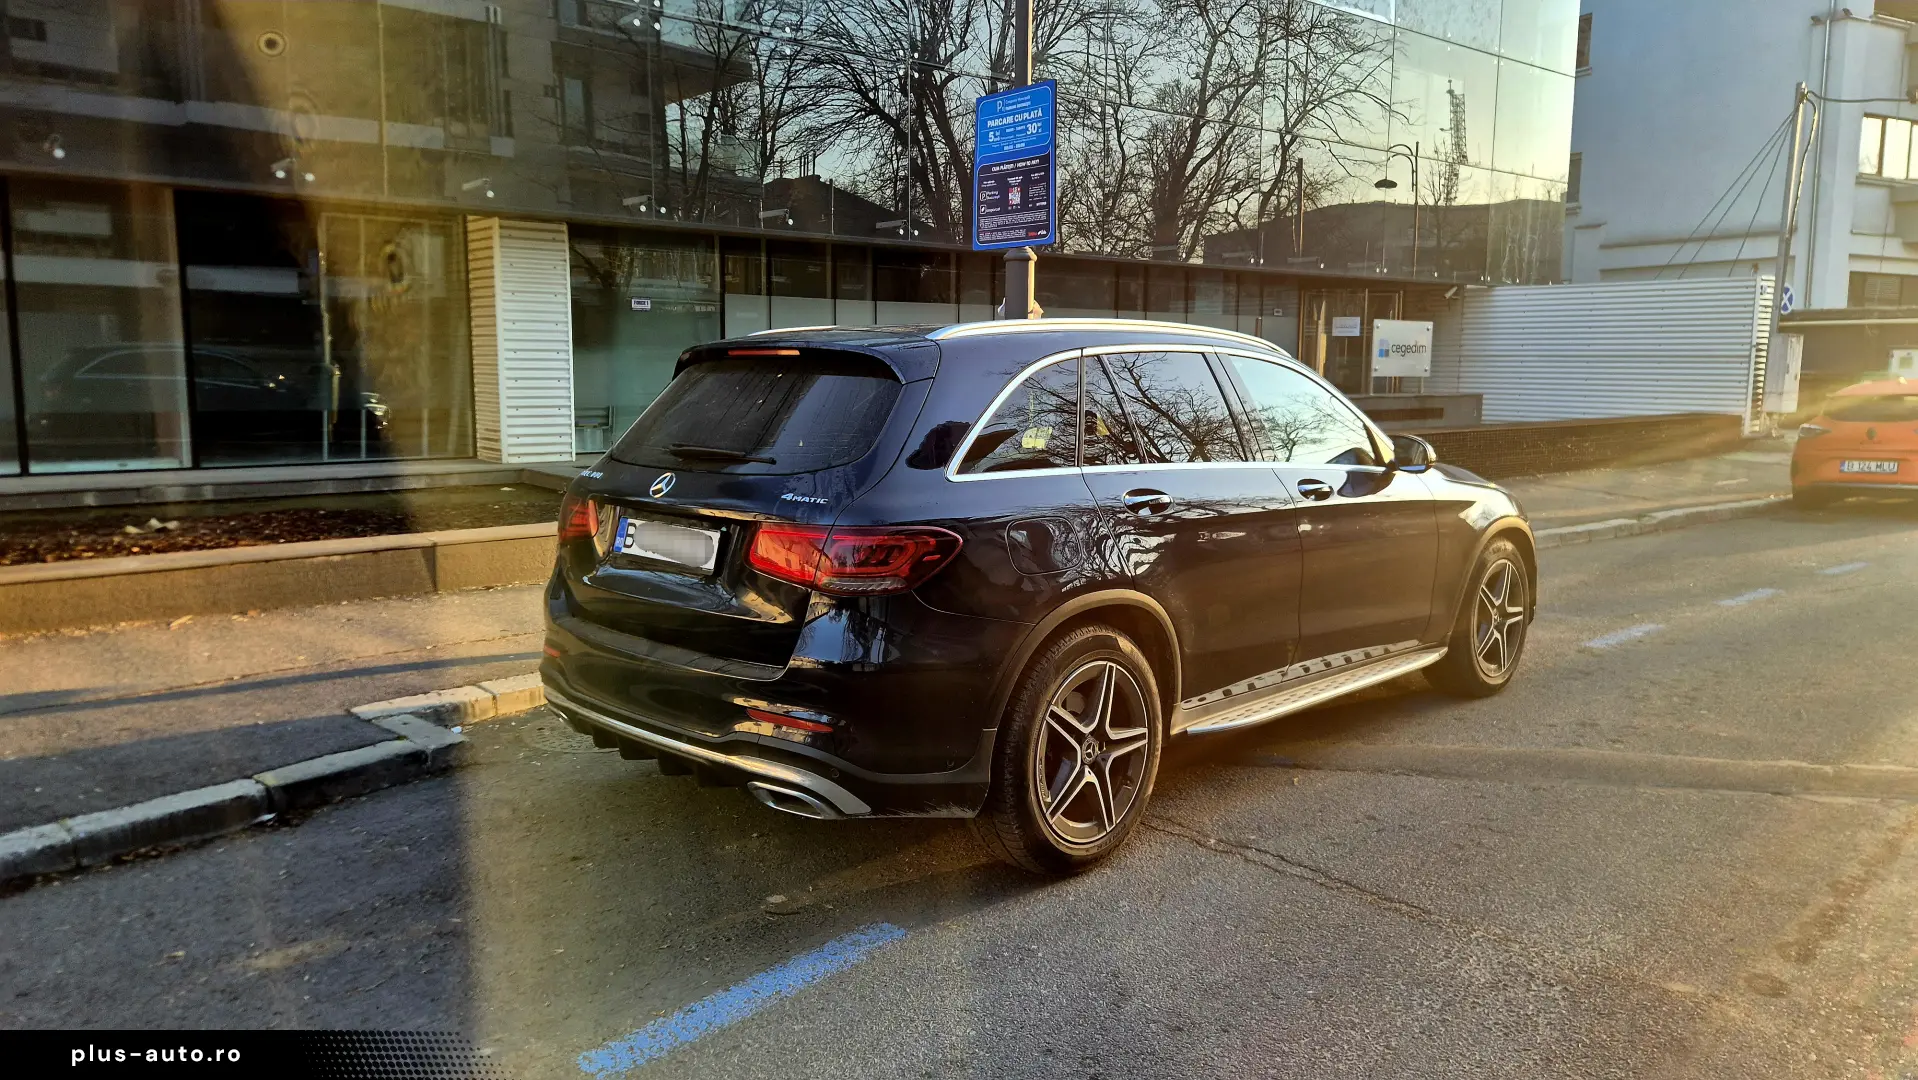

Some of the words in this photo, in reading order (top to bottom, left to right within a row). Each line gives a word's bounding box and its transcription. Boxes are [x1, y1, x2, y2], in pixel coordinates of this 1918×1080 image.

[987, 116, 1013, 128] PARCARE
[1014, 113, 1023, 122] CU
[1026, 122, 1038, 135] 30
[988, 131, 995, 142] 5
[1391, 340, 1427, 357] cegedim
[781, 493, 829, 504] 4MATIC
